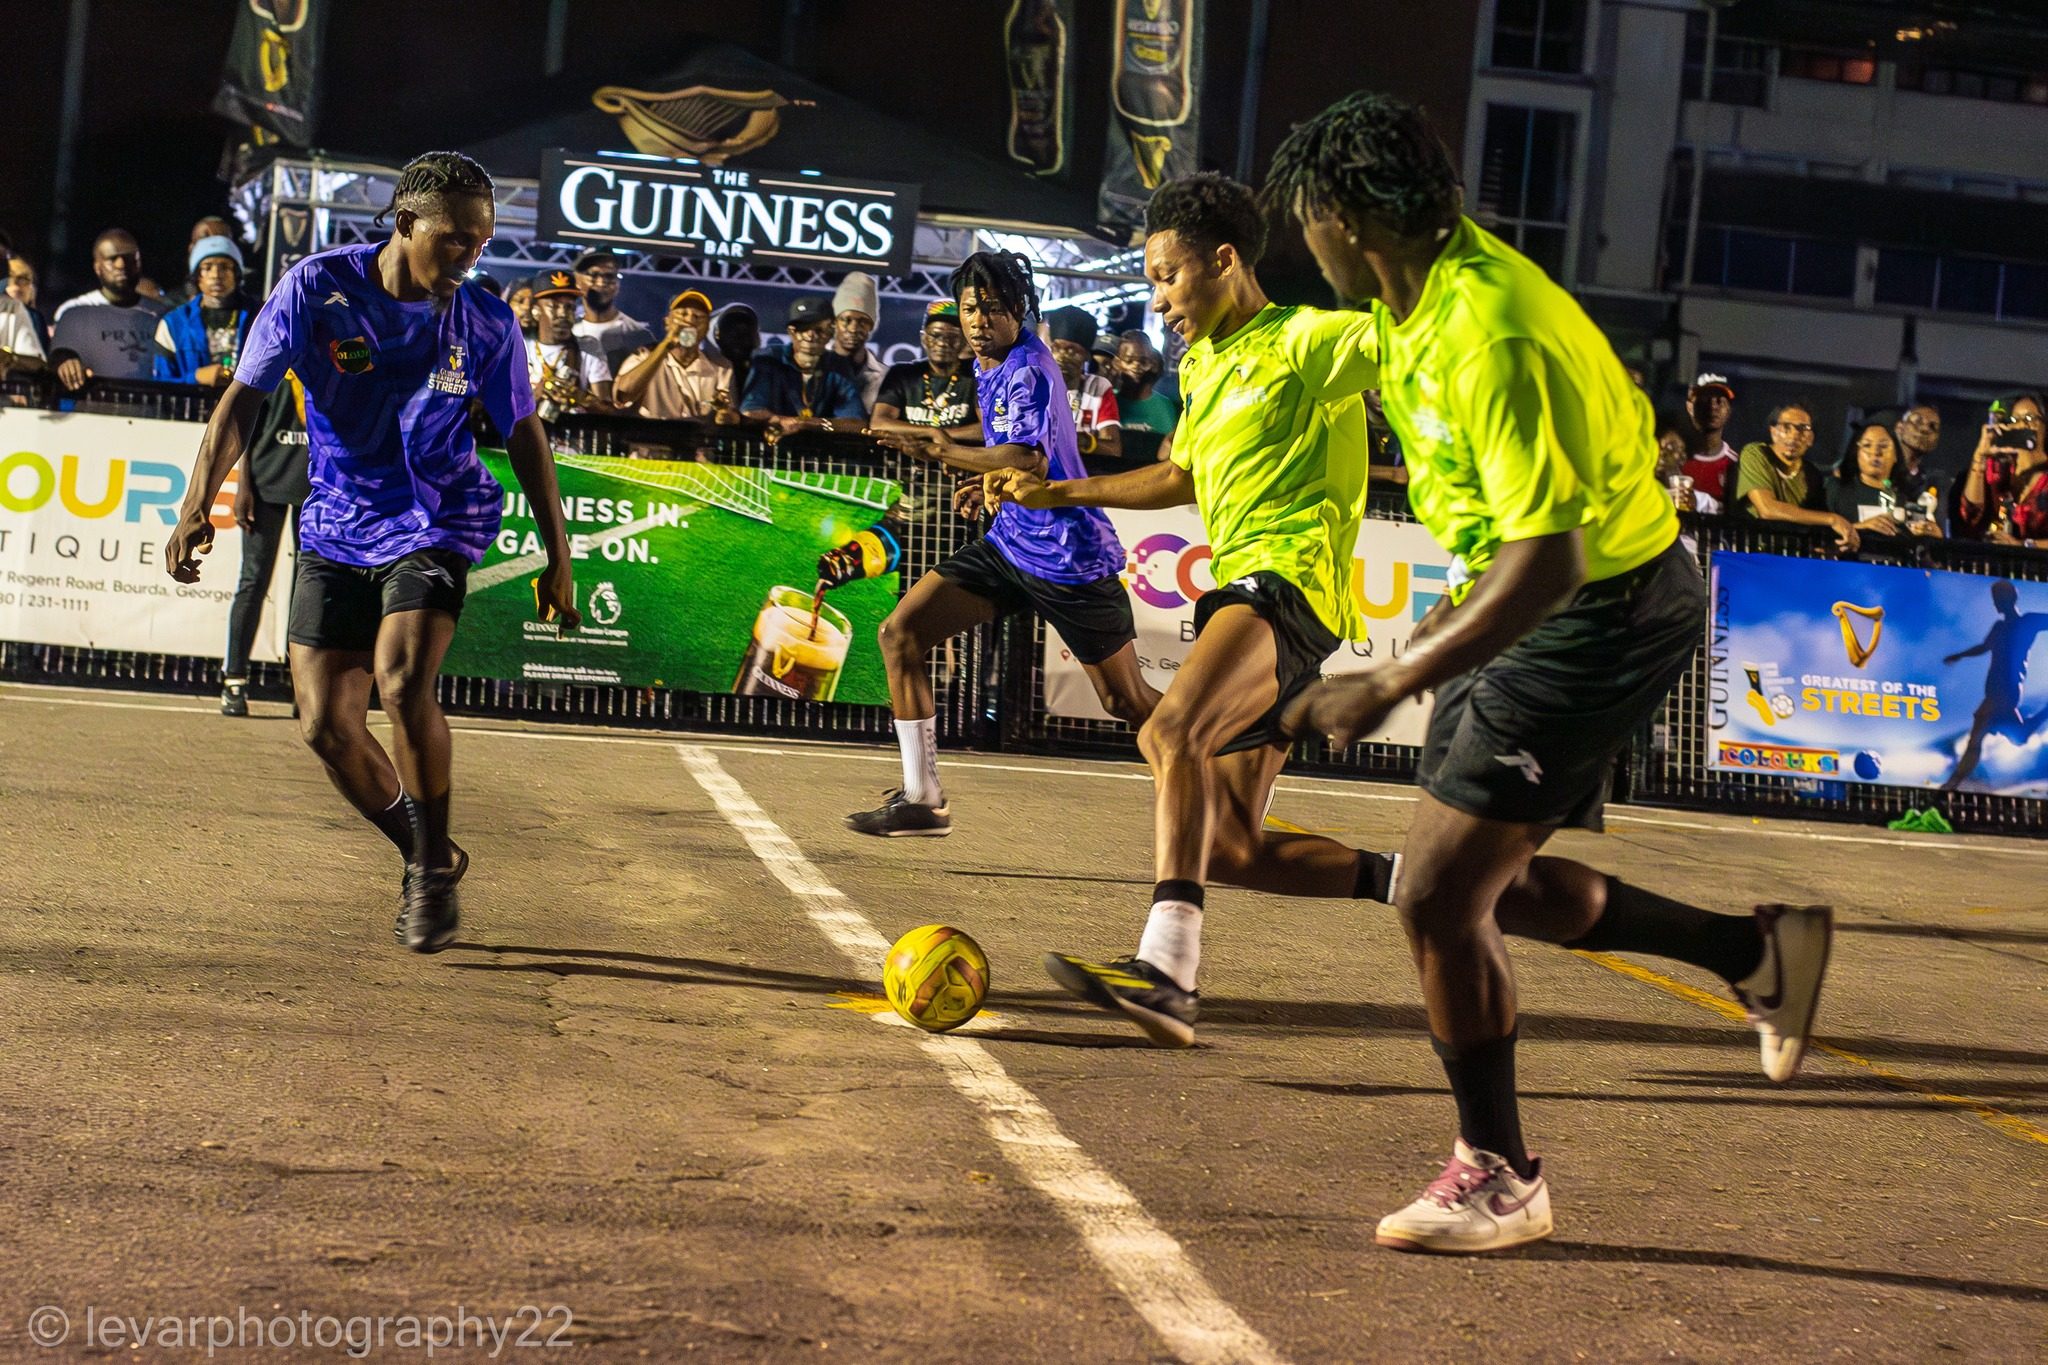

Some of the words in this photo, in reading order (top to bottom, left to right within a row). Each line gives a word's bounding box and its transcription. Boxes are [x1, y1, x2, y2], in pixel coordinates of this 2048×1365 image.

[712, 169, 749, 187] THE
[559, 166, 894, 257] GUINNESS
[704, 240, 744, 258] BAR
[427, 378, 468, 396] STREETS
[647, 502, 689, 529] IN.
[496, 529, 590, 560] GAE
[601, 536, 659, 564] ON.
[7, 572, 60, 588] Regent
[176, 586, 232, 603] George
[27, 595, 90, 612] 231-1111
[1707, 586, 1730, 730] GUINNESS
[1801, 674, 1877, 692] GREATEST
[1882, 680, 1903, 694] OF
[1907, 683, 1937, 698] THE
[1801, 688, 1942, 722] STREETS
[1723, 747, 1834, 774] COLOURS
